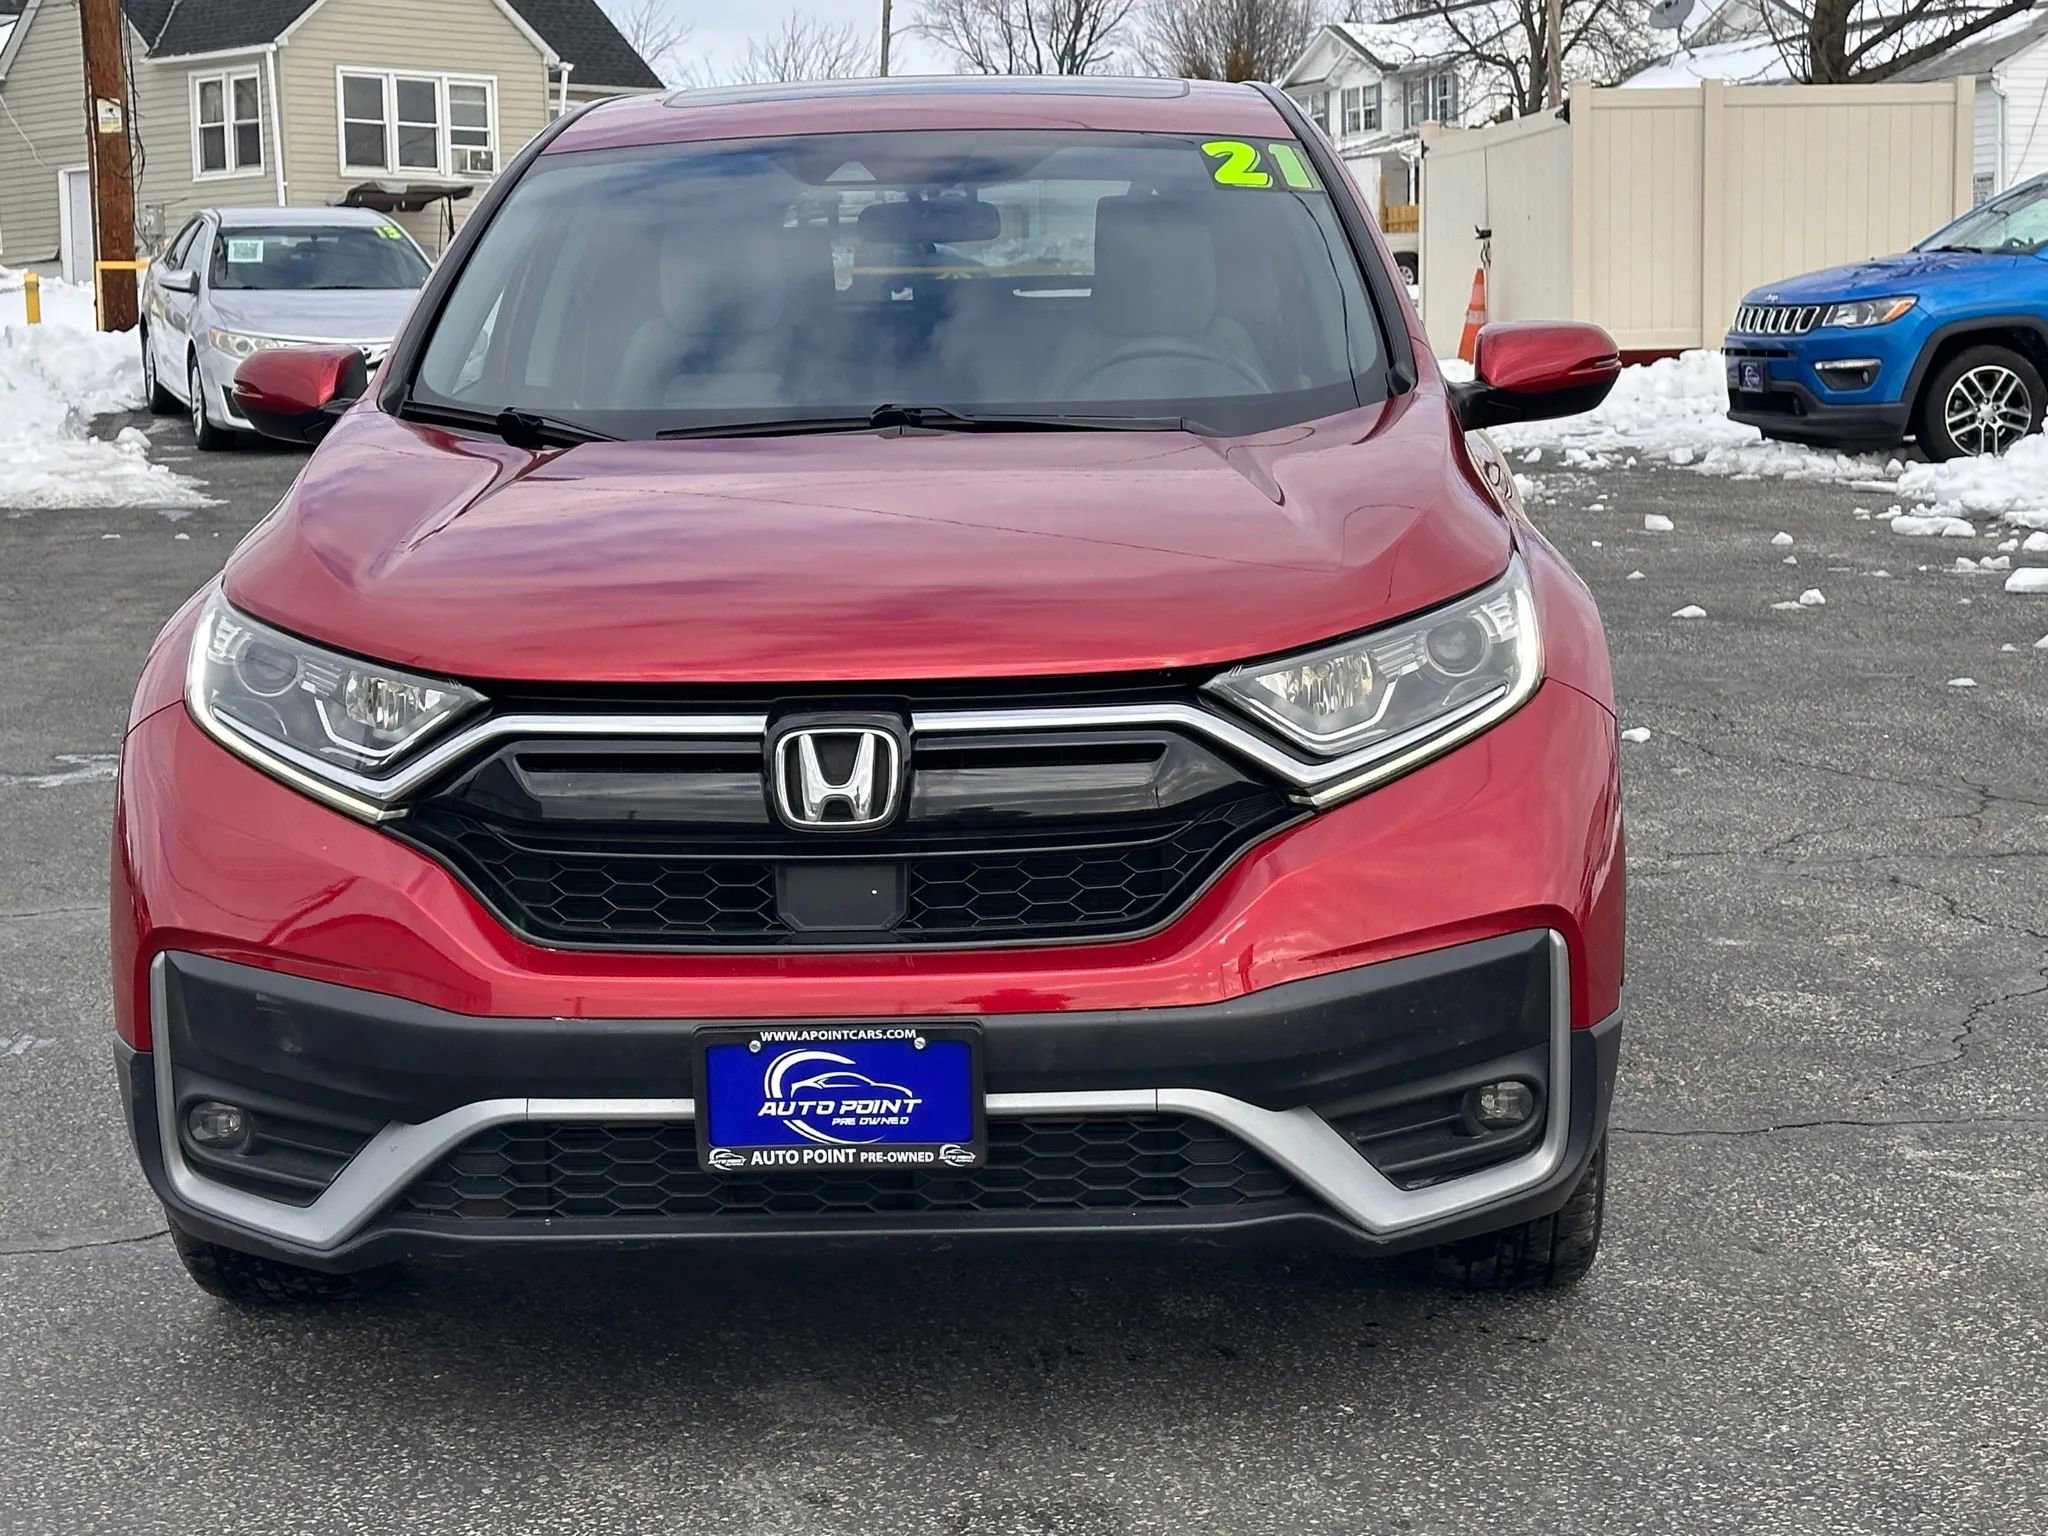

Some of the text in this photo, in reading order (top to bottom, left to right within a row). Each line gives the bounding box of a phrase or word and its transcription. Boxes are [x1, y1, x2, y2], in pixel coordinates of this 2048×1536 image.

[1201, 140, 1316, 188] 21
[760, 1029, 917, 1042] WWW.APOINTCARS.COM
[758, 1098, 922, 1117] AUTO POINT
[831, 1116, 909, 1126] PRE OWNED
[751, 1149, 799, 1166] AUTO
[803, 1148, 856, 1165] POINT
[860, 1150, 934, 1164] PRE-OWNED
